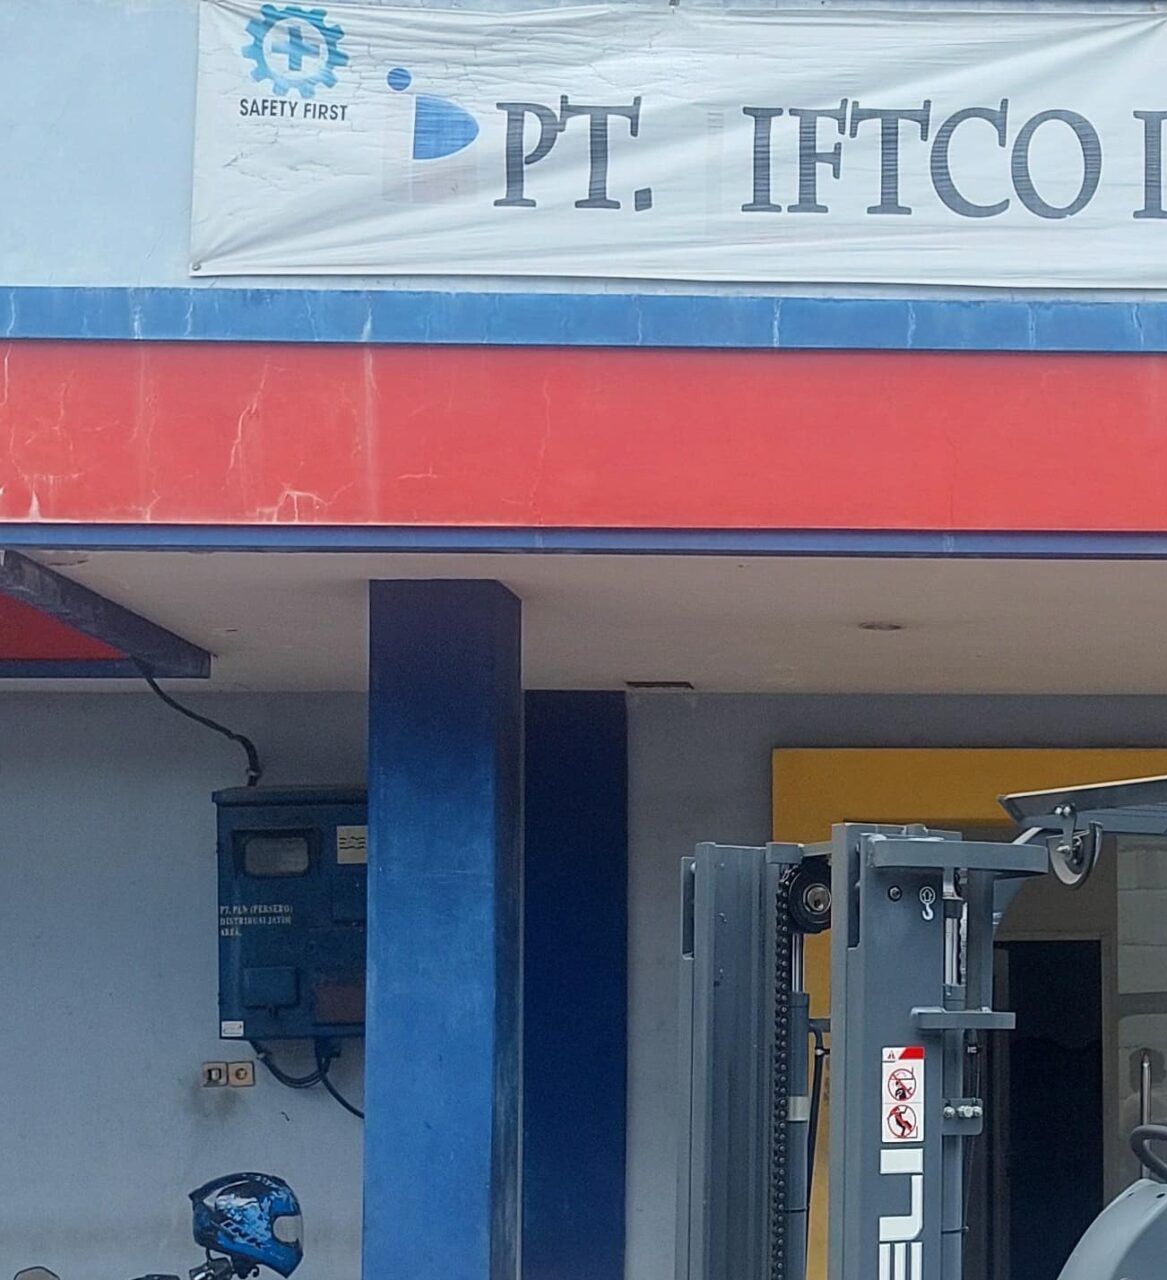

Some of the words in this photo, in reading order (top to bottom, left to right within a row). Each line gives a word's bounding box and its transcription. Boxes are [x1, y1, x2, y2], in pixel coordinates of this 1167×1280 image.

[240, 98, 298, 117] SAFETY
[303, 102, 348, 121] FIRST
[493, 94, 652, 212] PT.
[741, 97, 1102, 219] IFTCO
